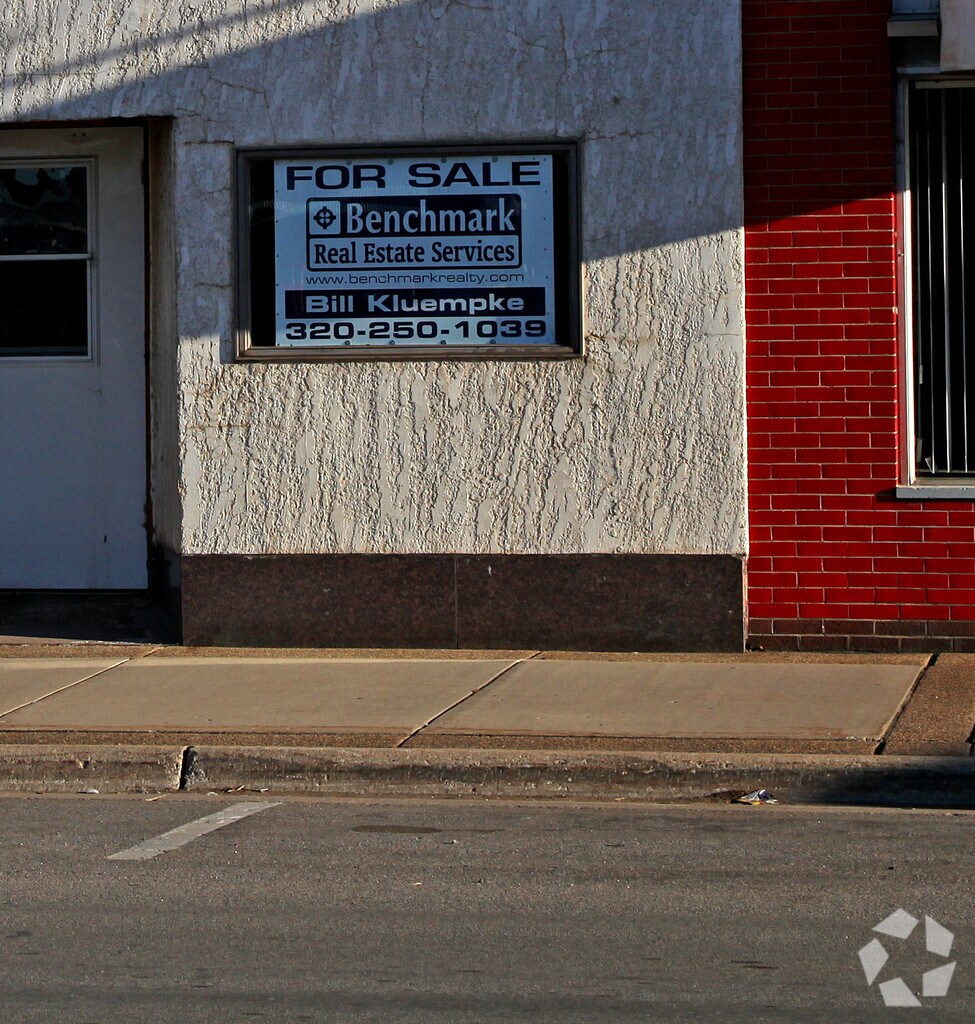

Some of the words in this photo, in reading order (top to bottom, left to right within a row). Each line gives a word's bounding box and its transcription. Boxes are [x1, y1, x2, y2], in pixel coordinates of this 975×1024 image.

[286, 164, 386, 190] FOR
[408, 161, 541, 188] SALE
[346, 198, 516, 234] Benchmark
[314, 241, 357, 264] Real
[363, 242, 424, 264] Estate
[431, 239, 515, 263] Services
[305, 272, 525, 284] www.benchmarkrealty.com
[305, 295, 354, 313] Bill
[367, 293, 524, 315] Kluempke
[285, 320, 547, 341] 320-250-1039
